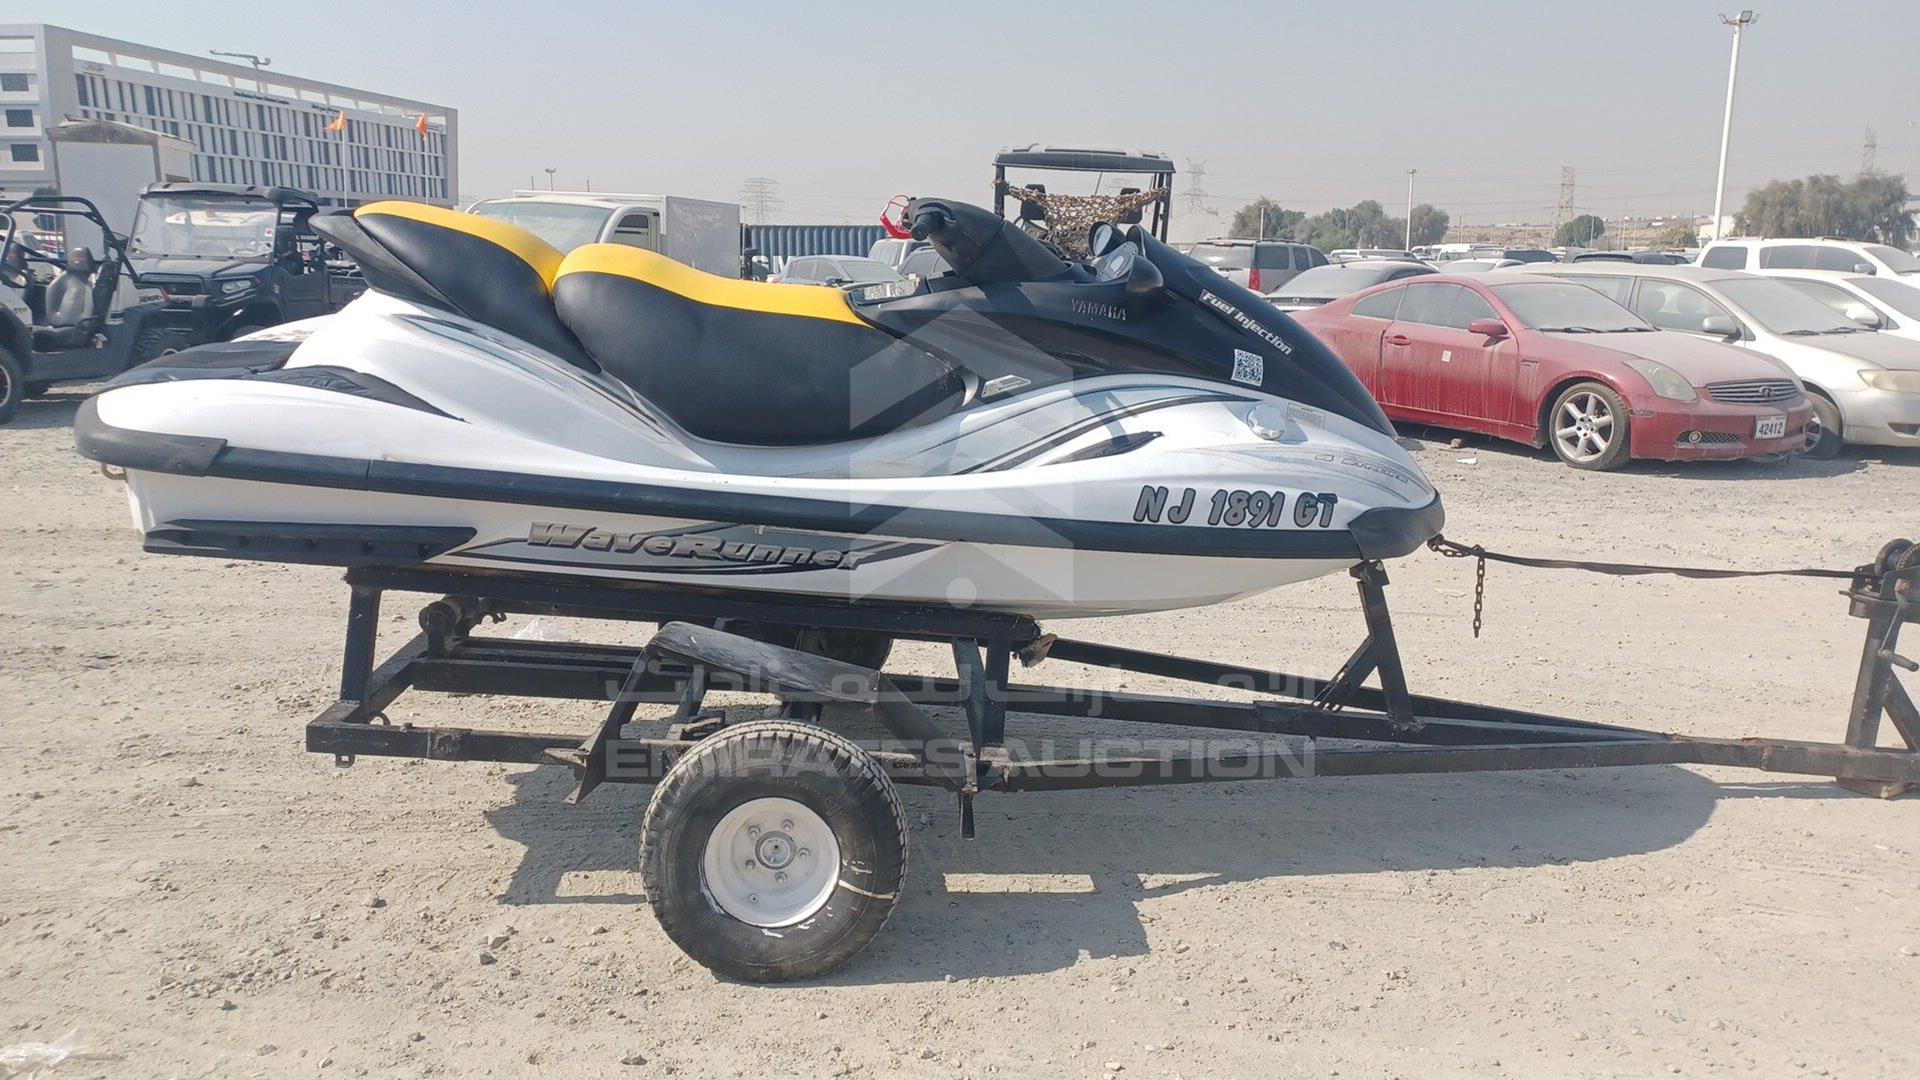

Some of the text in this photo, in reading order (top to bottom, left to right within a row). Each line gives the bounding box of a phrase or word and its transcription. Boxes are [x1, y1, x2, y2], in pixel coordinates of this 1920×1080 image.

[1071, 298, 1127, 320] YAMAHA
[1202, 292, 1293, 356] Fuel Injection
[1758, 422, 1783, 435] 42412
[1207, 489, 1286, 528] 1891
[1293, 492, 1338, 528] GT
[527, 521, 868, 570] WaveRunner
